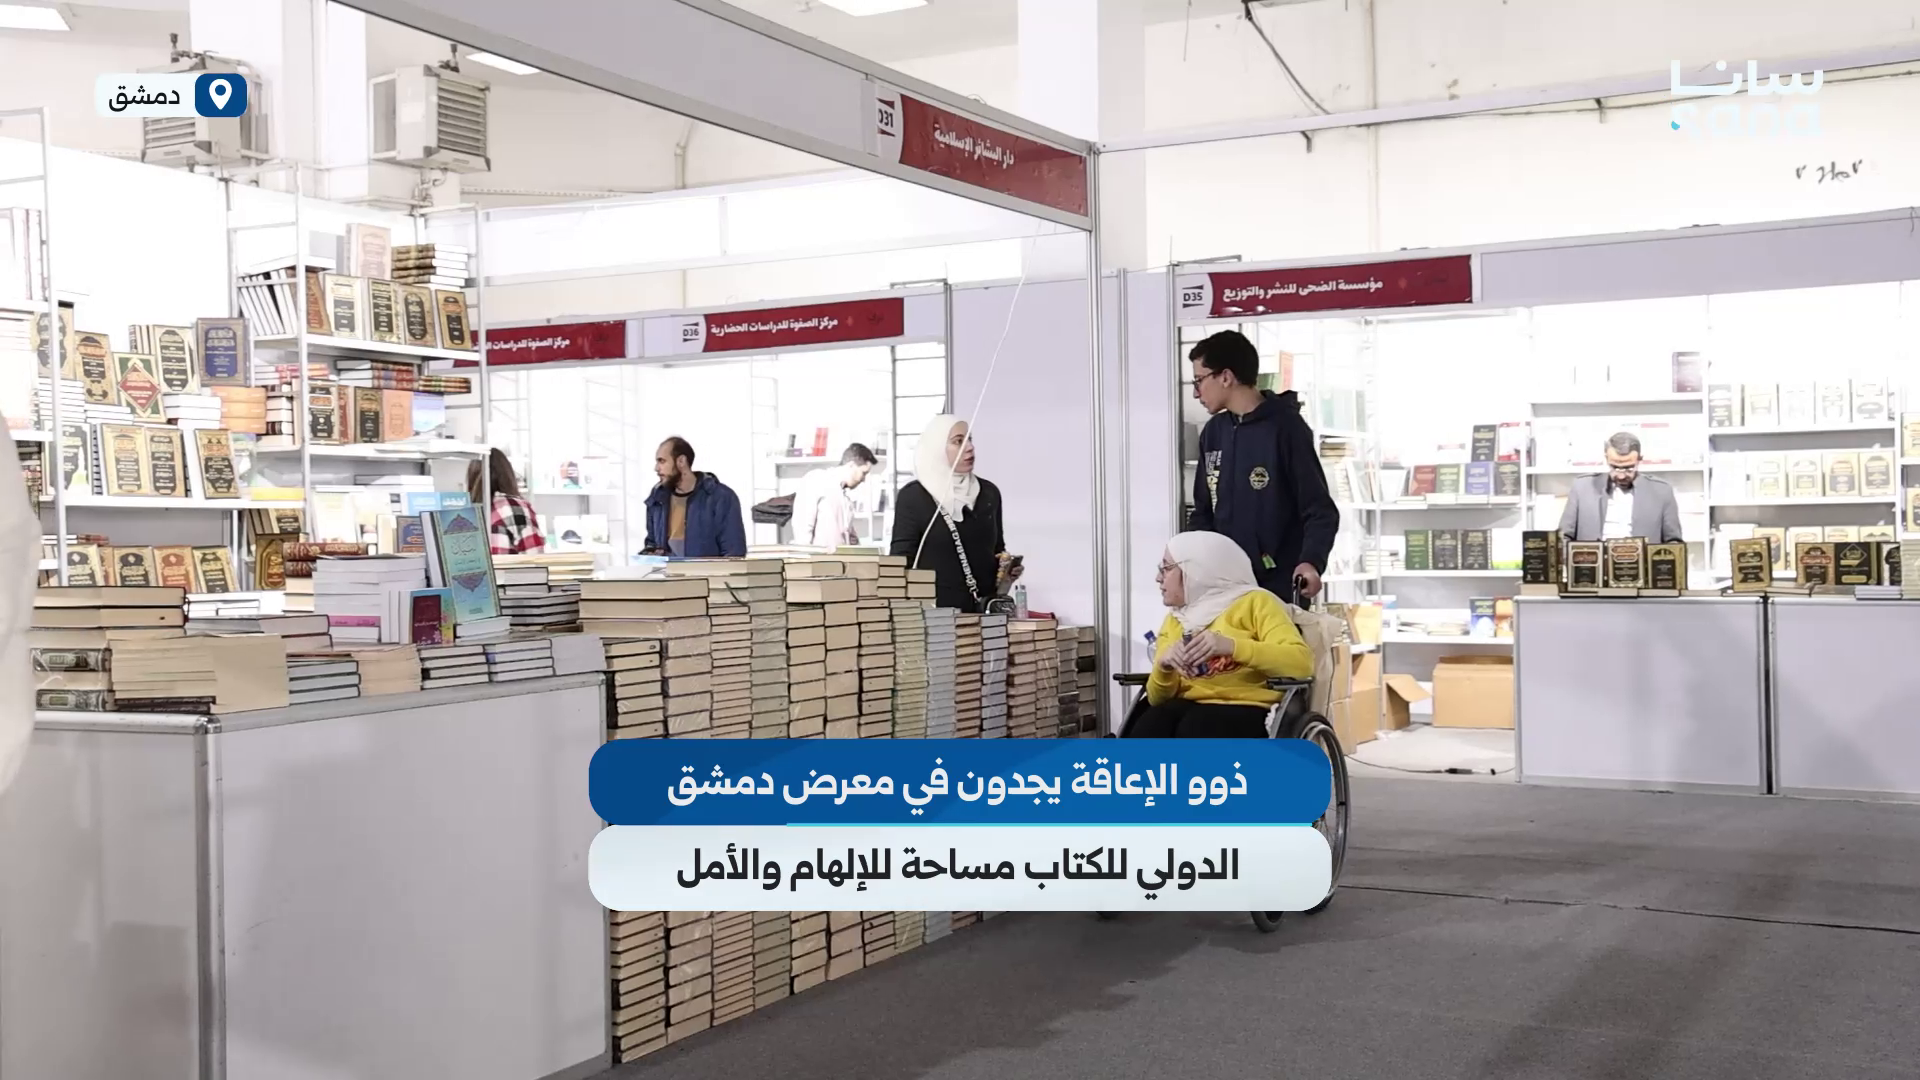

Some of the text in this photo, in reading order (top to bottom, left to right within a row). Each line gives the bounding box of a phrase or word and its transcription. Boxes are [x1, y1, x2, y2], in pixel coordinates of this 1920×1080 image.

[934, 123, 973, 157] الإسلامية
[1002, 151, 1015, 169] دار
[1183, 291, 1204, 302] D35
[1222, 276, 1384, 302] مؤسسة الضحى للنشر والتوزيع
[682, 328, 700, 338] D36
[709, 316, 839, 337] مركز الصفوة للدراسات الحضارية
[528, 338, 554, 351] الصفوة
[553, 336, 570, 349] مركز
